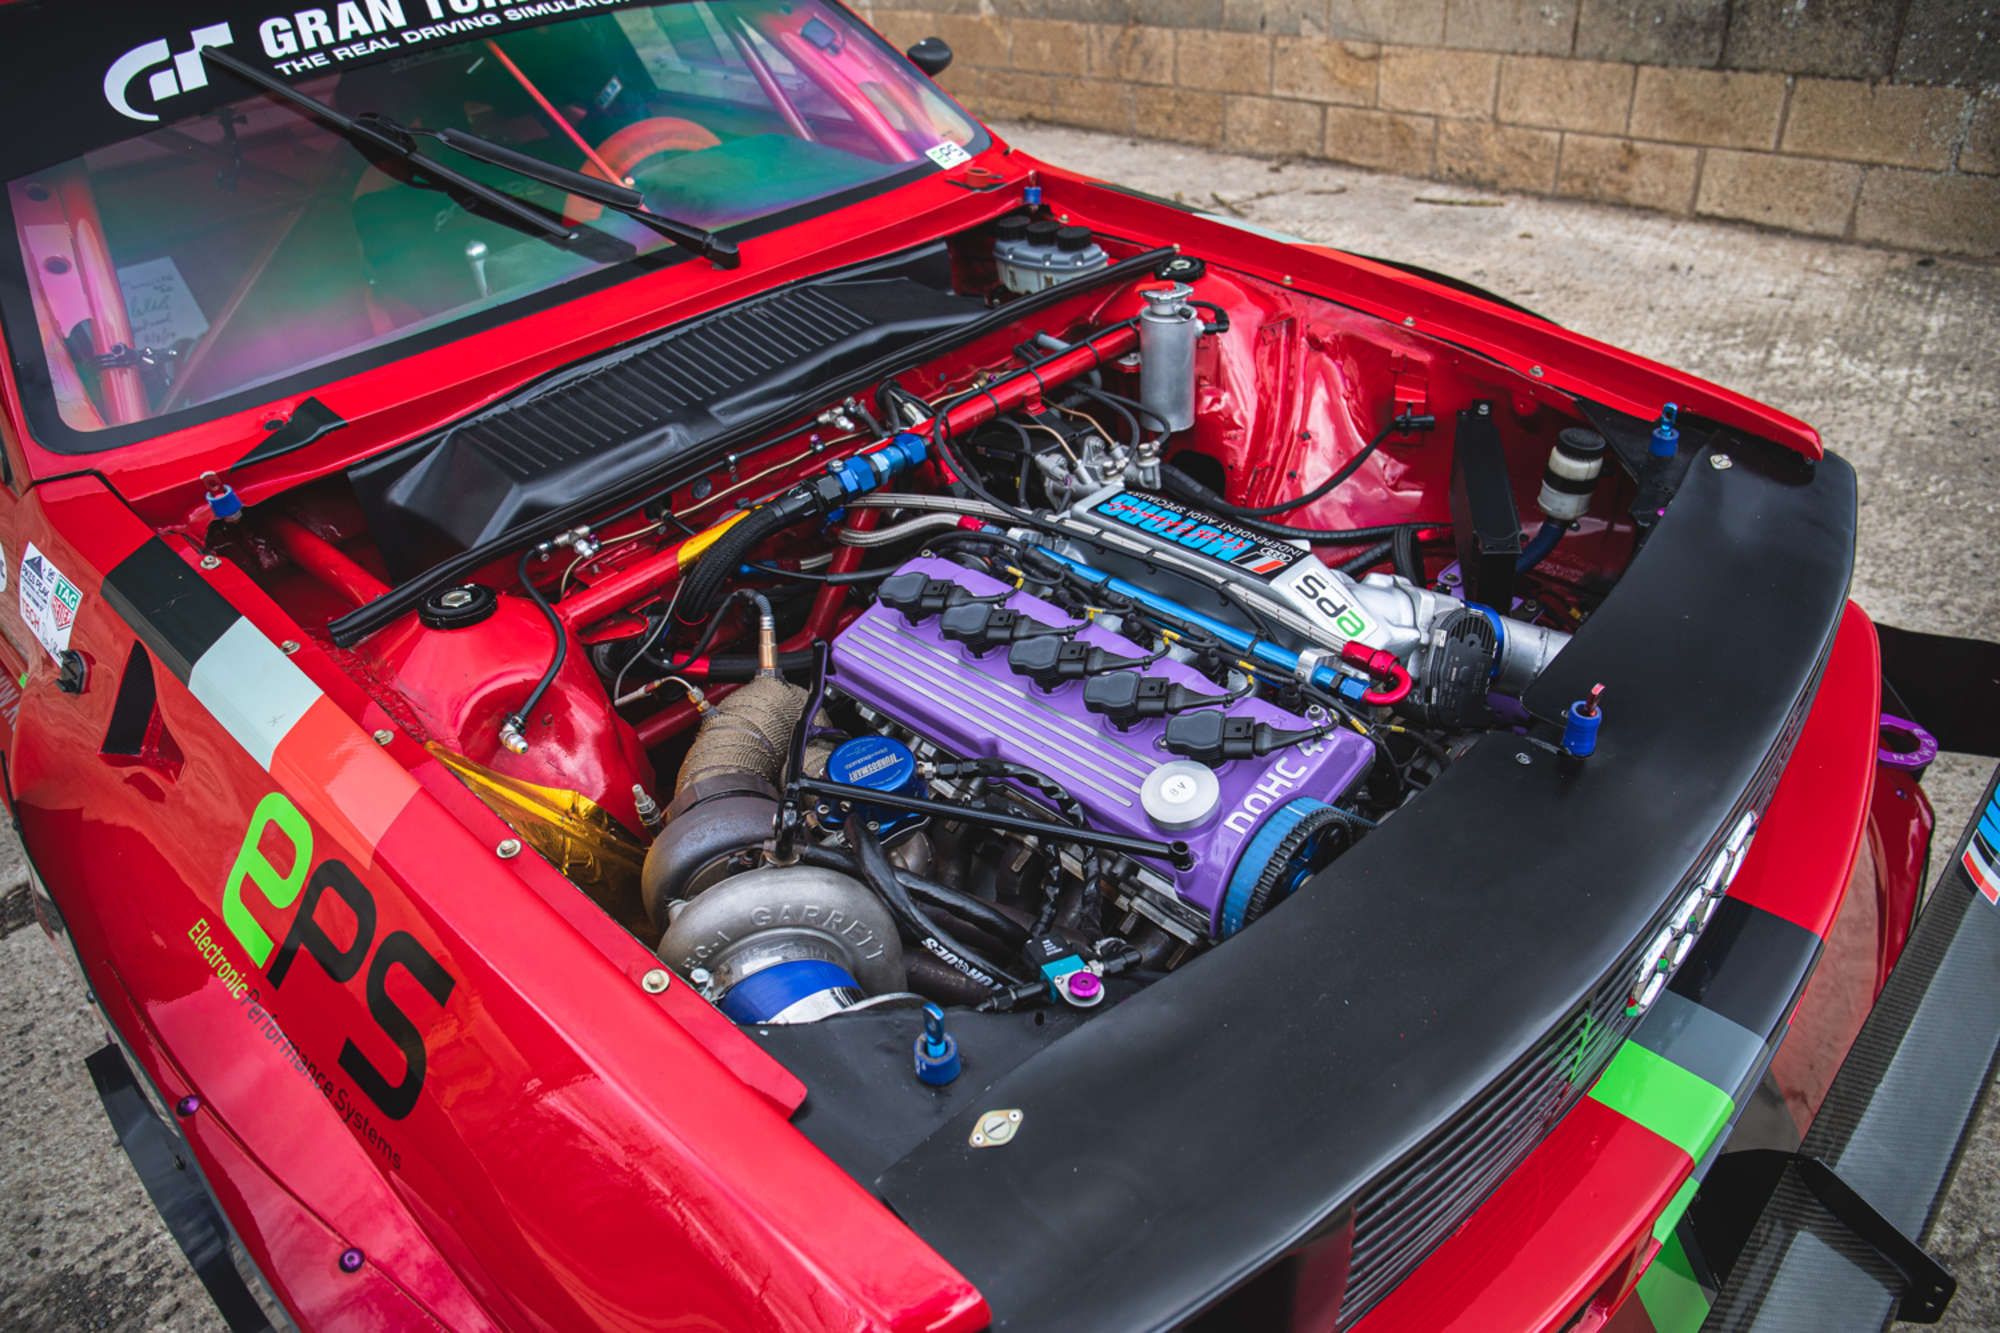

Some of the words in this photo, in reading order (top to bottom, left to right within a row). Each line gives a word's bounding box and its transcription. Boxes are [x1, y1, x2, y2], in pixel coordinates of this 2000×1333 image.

[259, 0, 408, 59] GRAN
[274, 52, 331, 76] THE
[332, 36, 400, 62] REAL
[400, 12, 502, 45] DRIVING
[1097, 493, 1257, 562] MOTORS
[1185, 509, 1218, 525] AUDI
[1217, 521, 1304, 557] INDEPENDENT
[56, 581, 78, 608] TAG
[752, 903, 885, 960] GARRETT
[187, 917, 250, 1000] Electronic
[240, 987, 335, 1102] Performance
[333, 1087, 403, 1170] Systems
